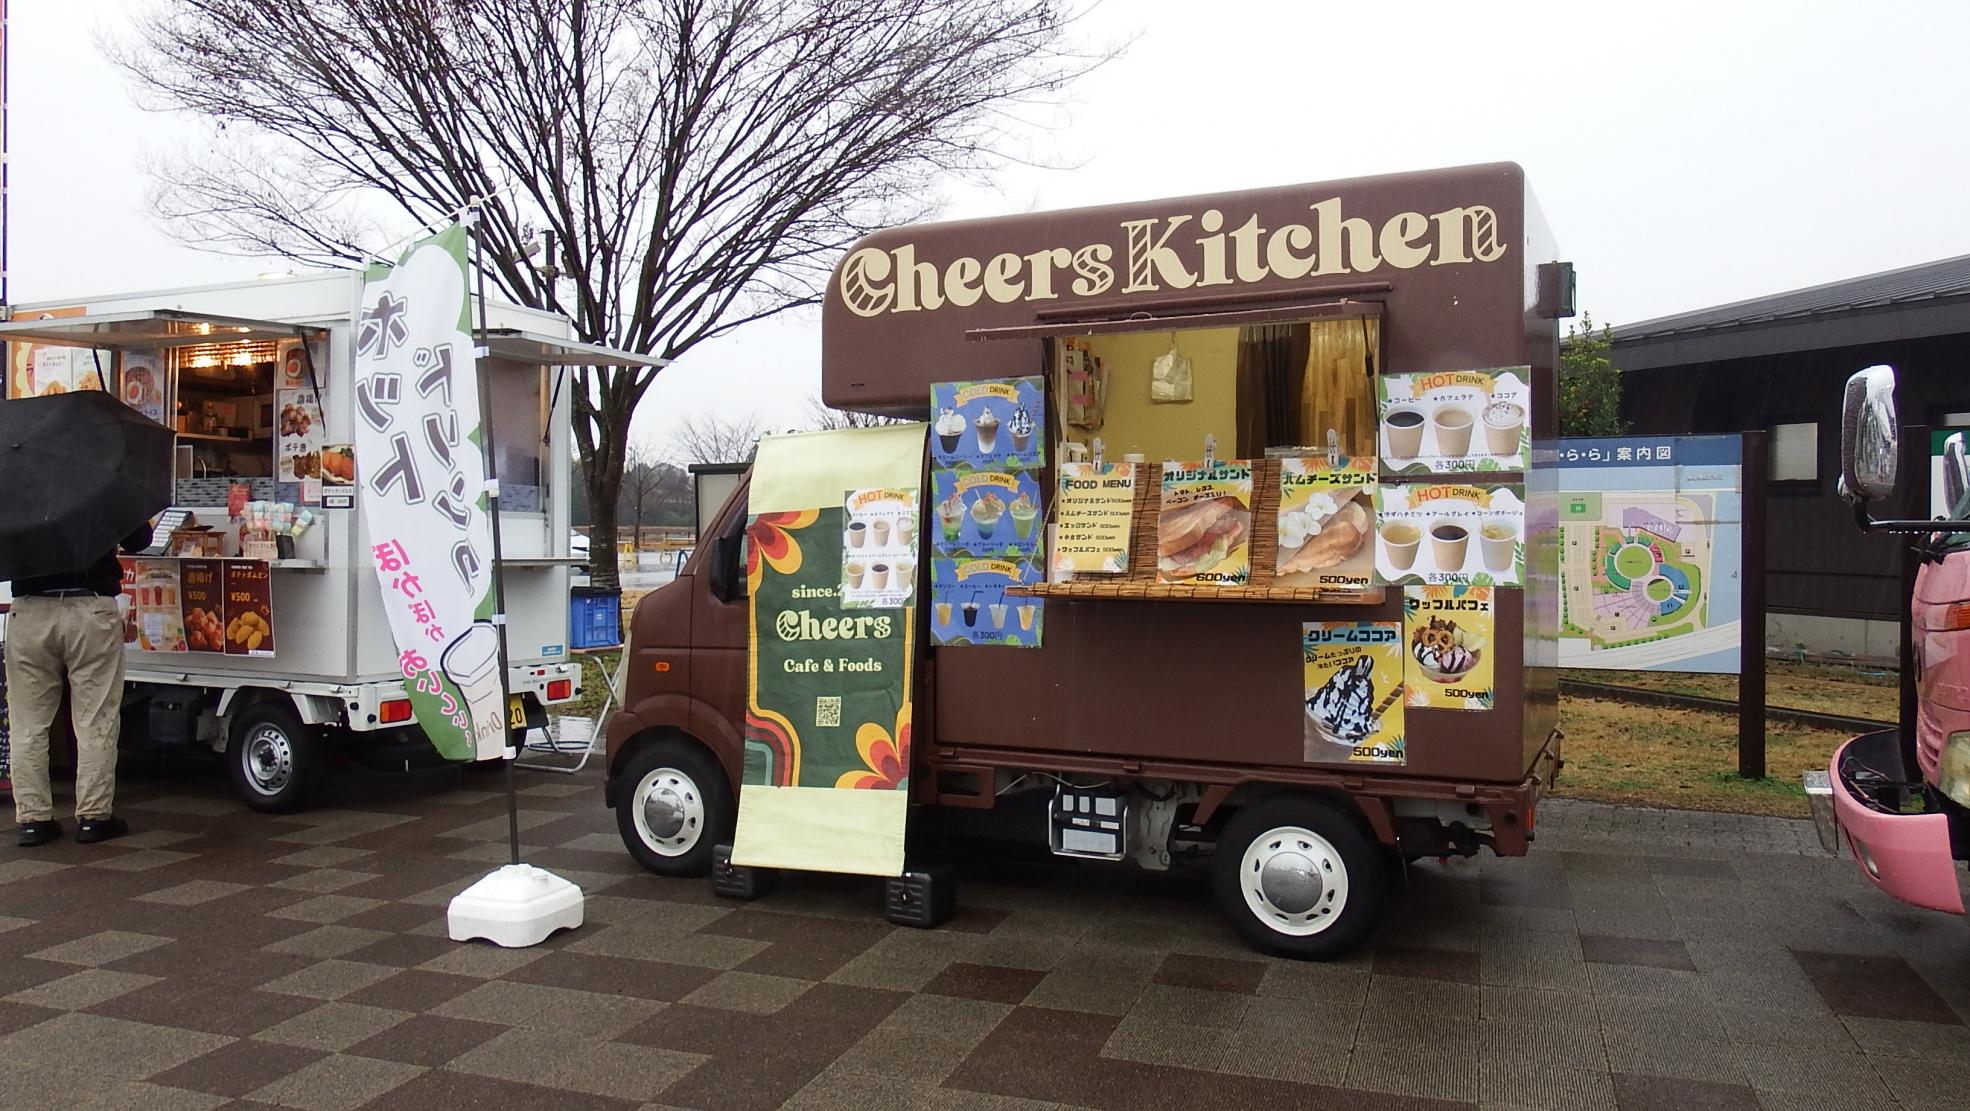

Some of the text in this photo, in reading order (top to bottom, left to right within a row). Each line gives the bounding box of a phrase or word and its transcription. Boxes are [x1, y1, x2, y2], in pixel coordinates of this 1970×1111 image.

[840, 197, 1508, 318] Cheers Kitchen
[1420, 373, 1485, 391] HOT DRINK
[962, 385, 1011, 398] COLD DRINK
[1434, 459, 1476, 471] 各300円
[962, 475, 1011, 487] COLD DRINK
[1163, 468, 1252, 482] オリジナルサンド
[1283, 472, 1377, 486] ハムチーズサンド
[1066, 479, 1132, 490] FOOD MENU
[858, 489, 905, 504] HOT DRINK
[1417, 486, 1481, 502] HOT DRINK
[963, 562, 1012, 574] COLD DRINK
[1195, 572, 1247, 584] 600yen
[1319, 575, 1369, 585] 500yen
[1427, 572, 1469, 583] 各300円
[230, 591, 251, 602] ¥500
[1408, 598, 1489, 611] ワッフルパフェ
[775, 609, 892, 641] Cheers
[1308, 629, 1397, 643] クリームココア
[783, 657, 882, 673] Cafe & Foods
[1444, 688, 1489, 699] 500yen
[1352, 746, 1404, 759] 500yen
